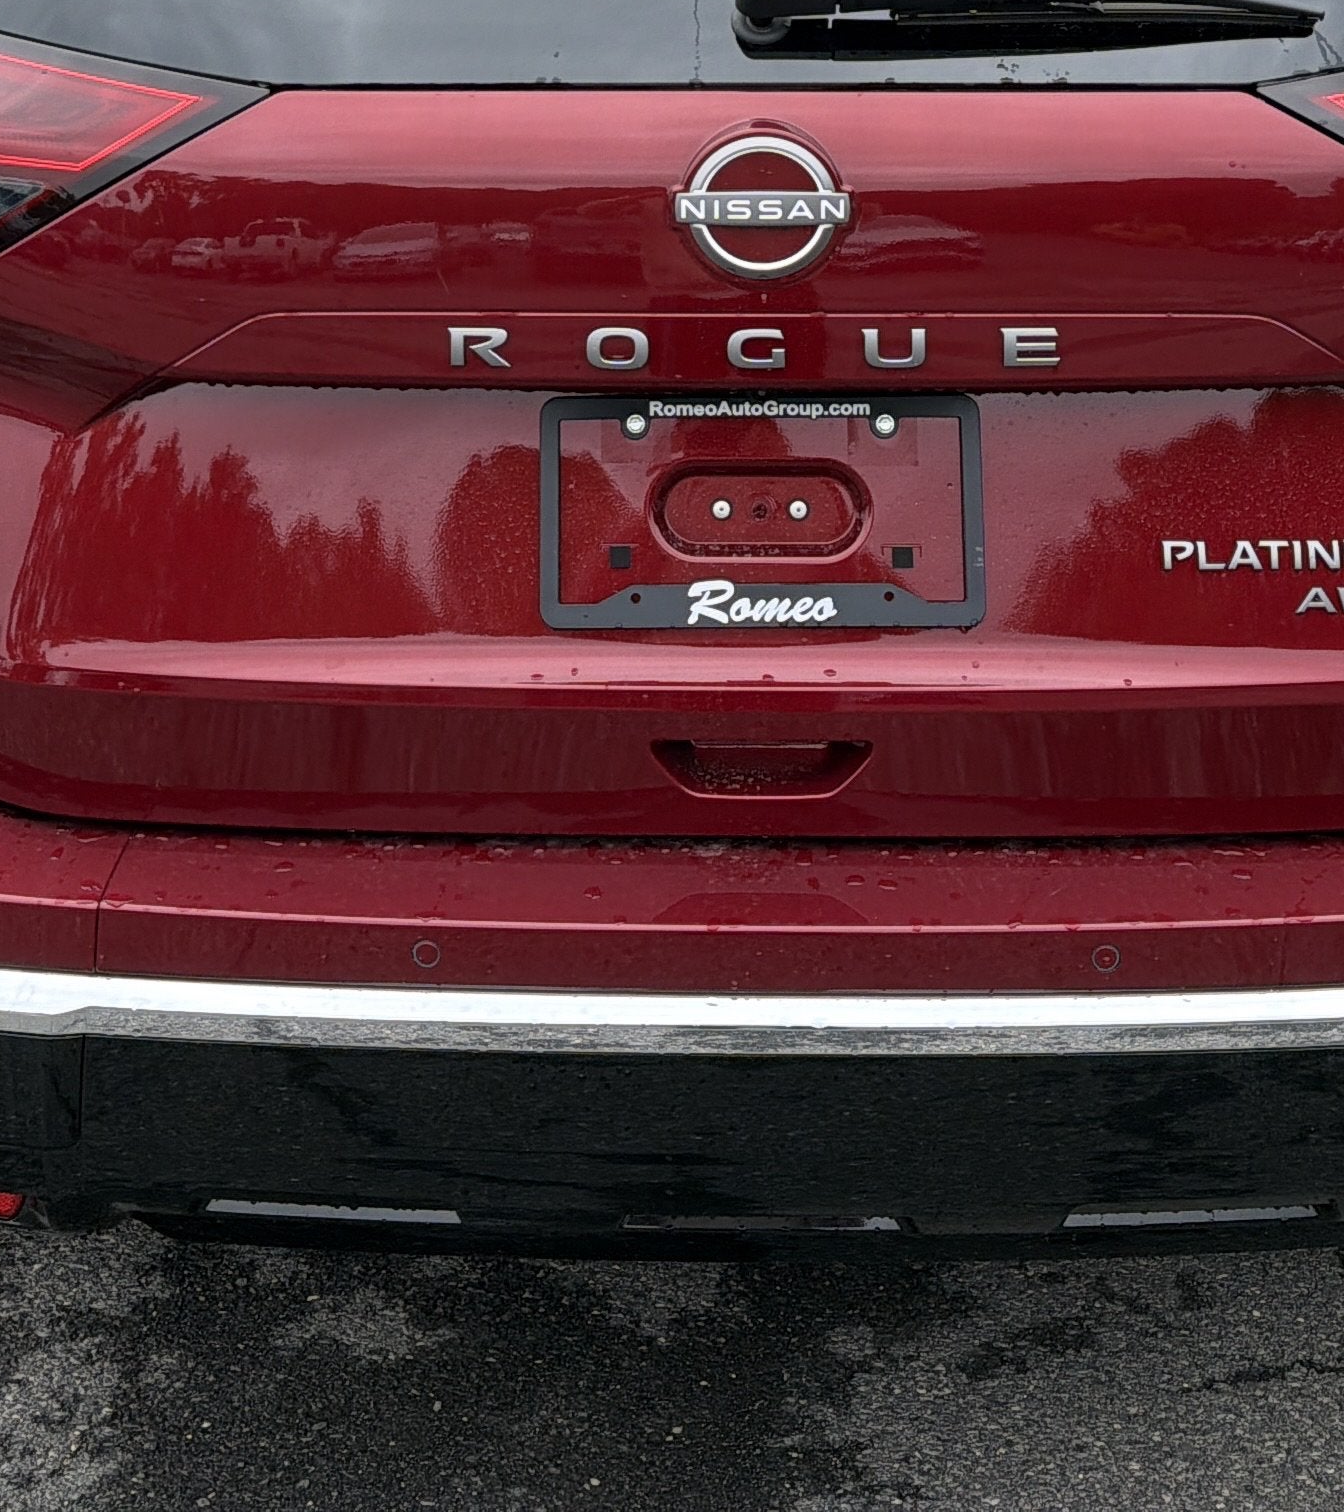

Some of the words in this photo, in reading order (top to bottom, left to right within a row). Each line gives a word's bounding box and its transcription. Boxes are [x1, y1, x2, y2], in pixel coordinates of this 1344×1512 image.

[680, 198, 845, 220] NISSAN
[447, 326, 1061, 369] ROGUE
[649, 400, 871, 419] RomeoAutoGroup.com
[687, 579, 838, 625] Romeo
